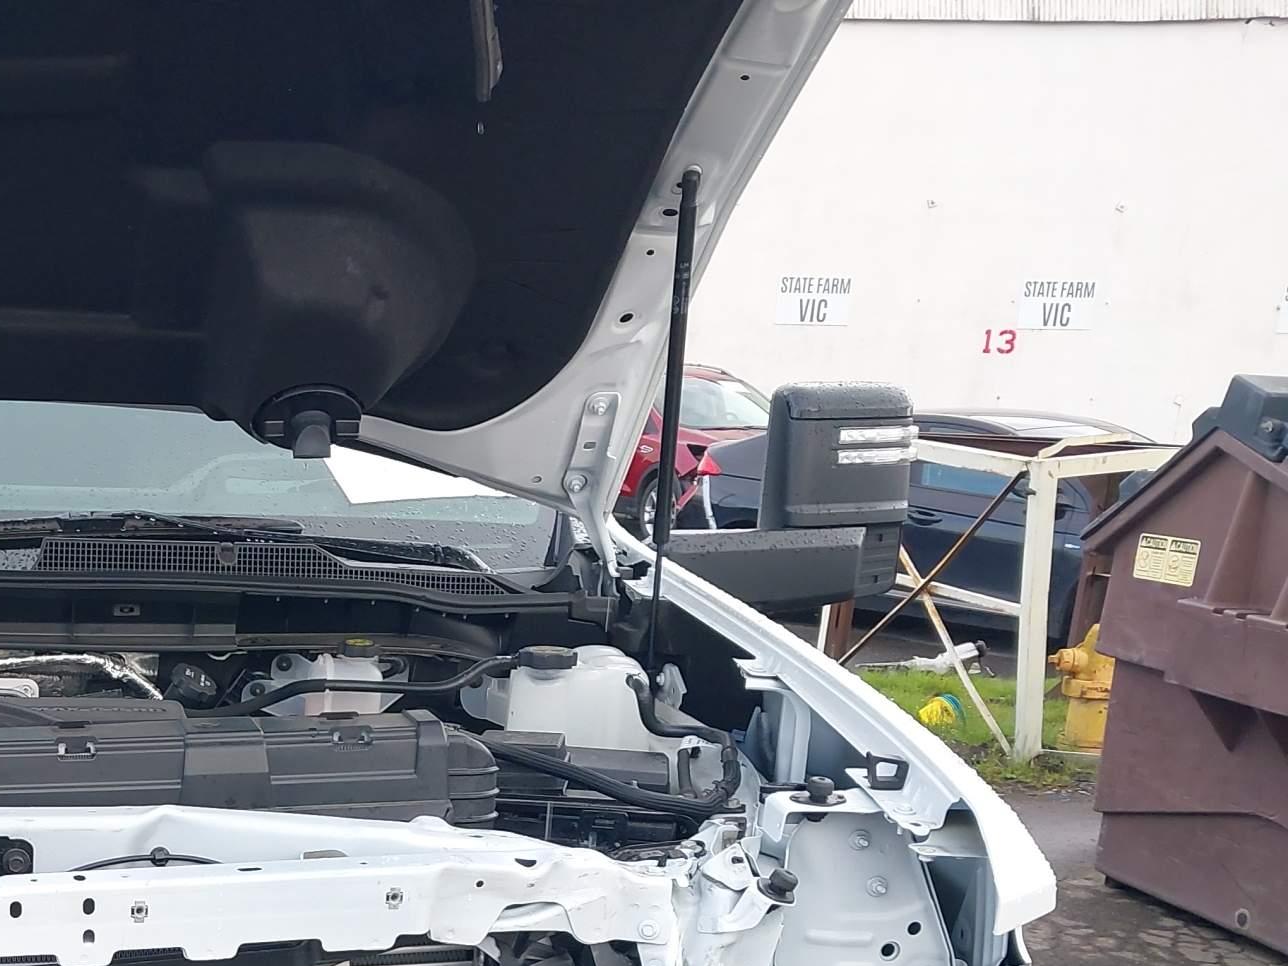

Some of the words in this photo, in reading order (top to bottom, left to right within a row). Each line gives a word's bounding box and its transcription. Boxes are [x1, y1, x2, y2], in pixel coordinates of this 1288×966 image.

[780, 276, 815, 294] STATE
[816, 277, 852, 294] FARM
[1024, 280, 1058, 298] STATE
[1060, 281, 1096, 298] FARM
[799, 298, 828, 323] VIC
[1042, 302, 1072, 327] VIC
[982, 329, 1017, 354] 13
